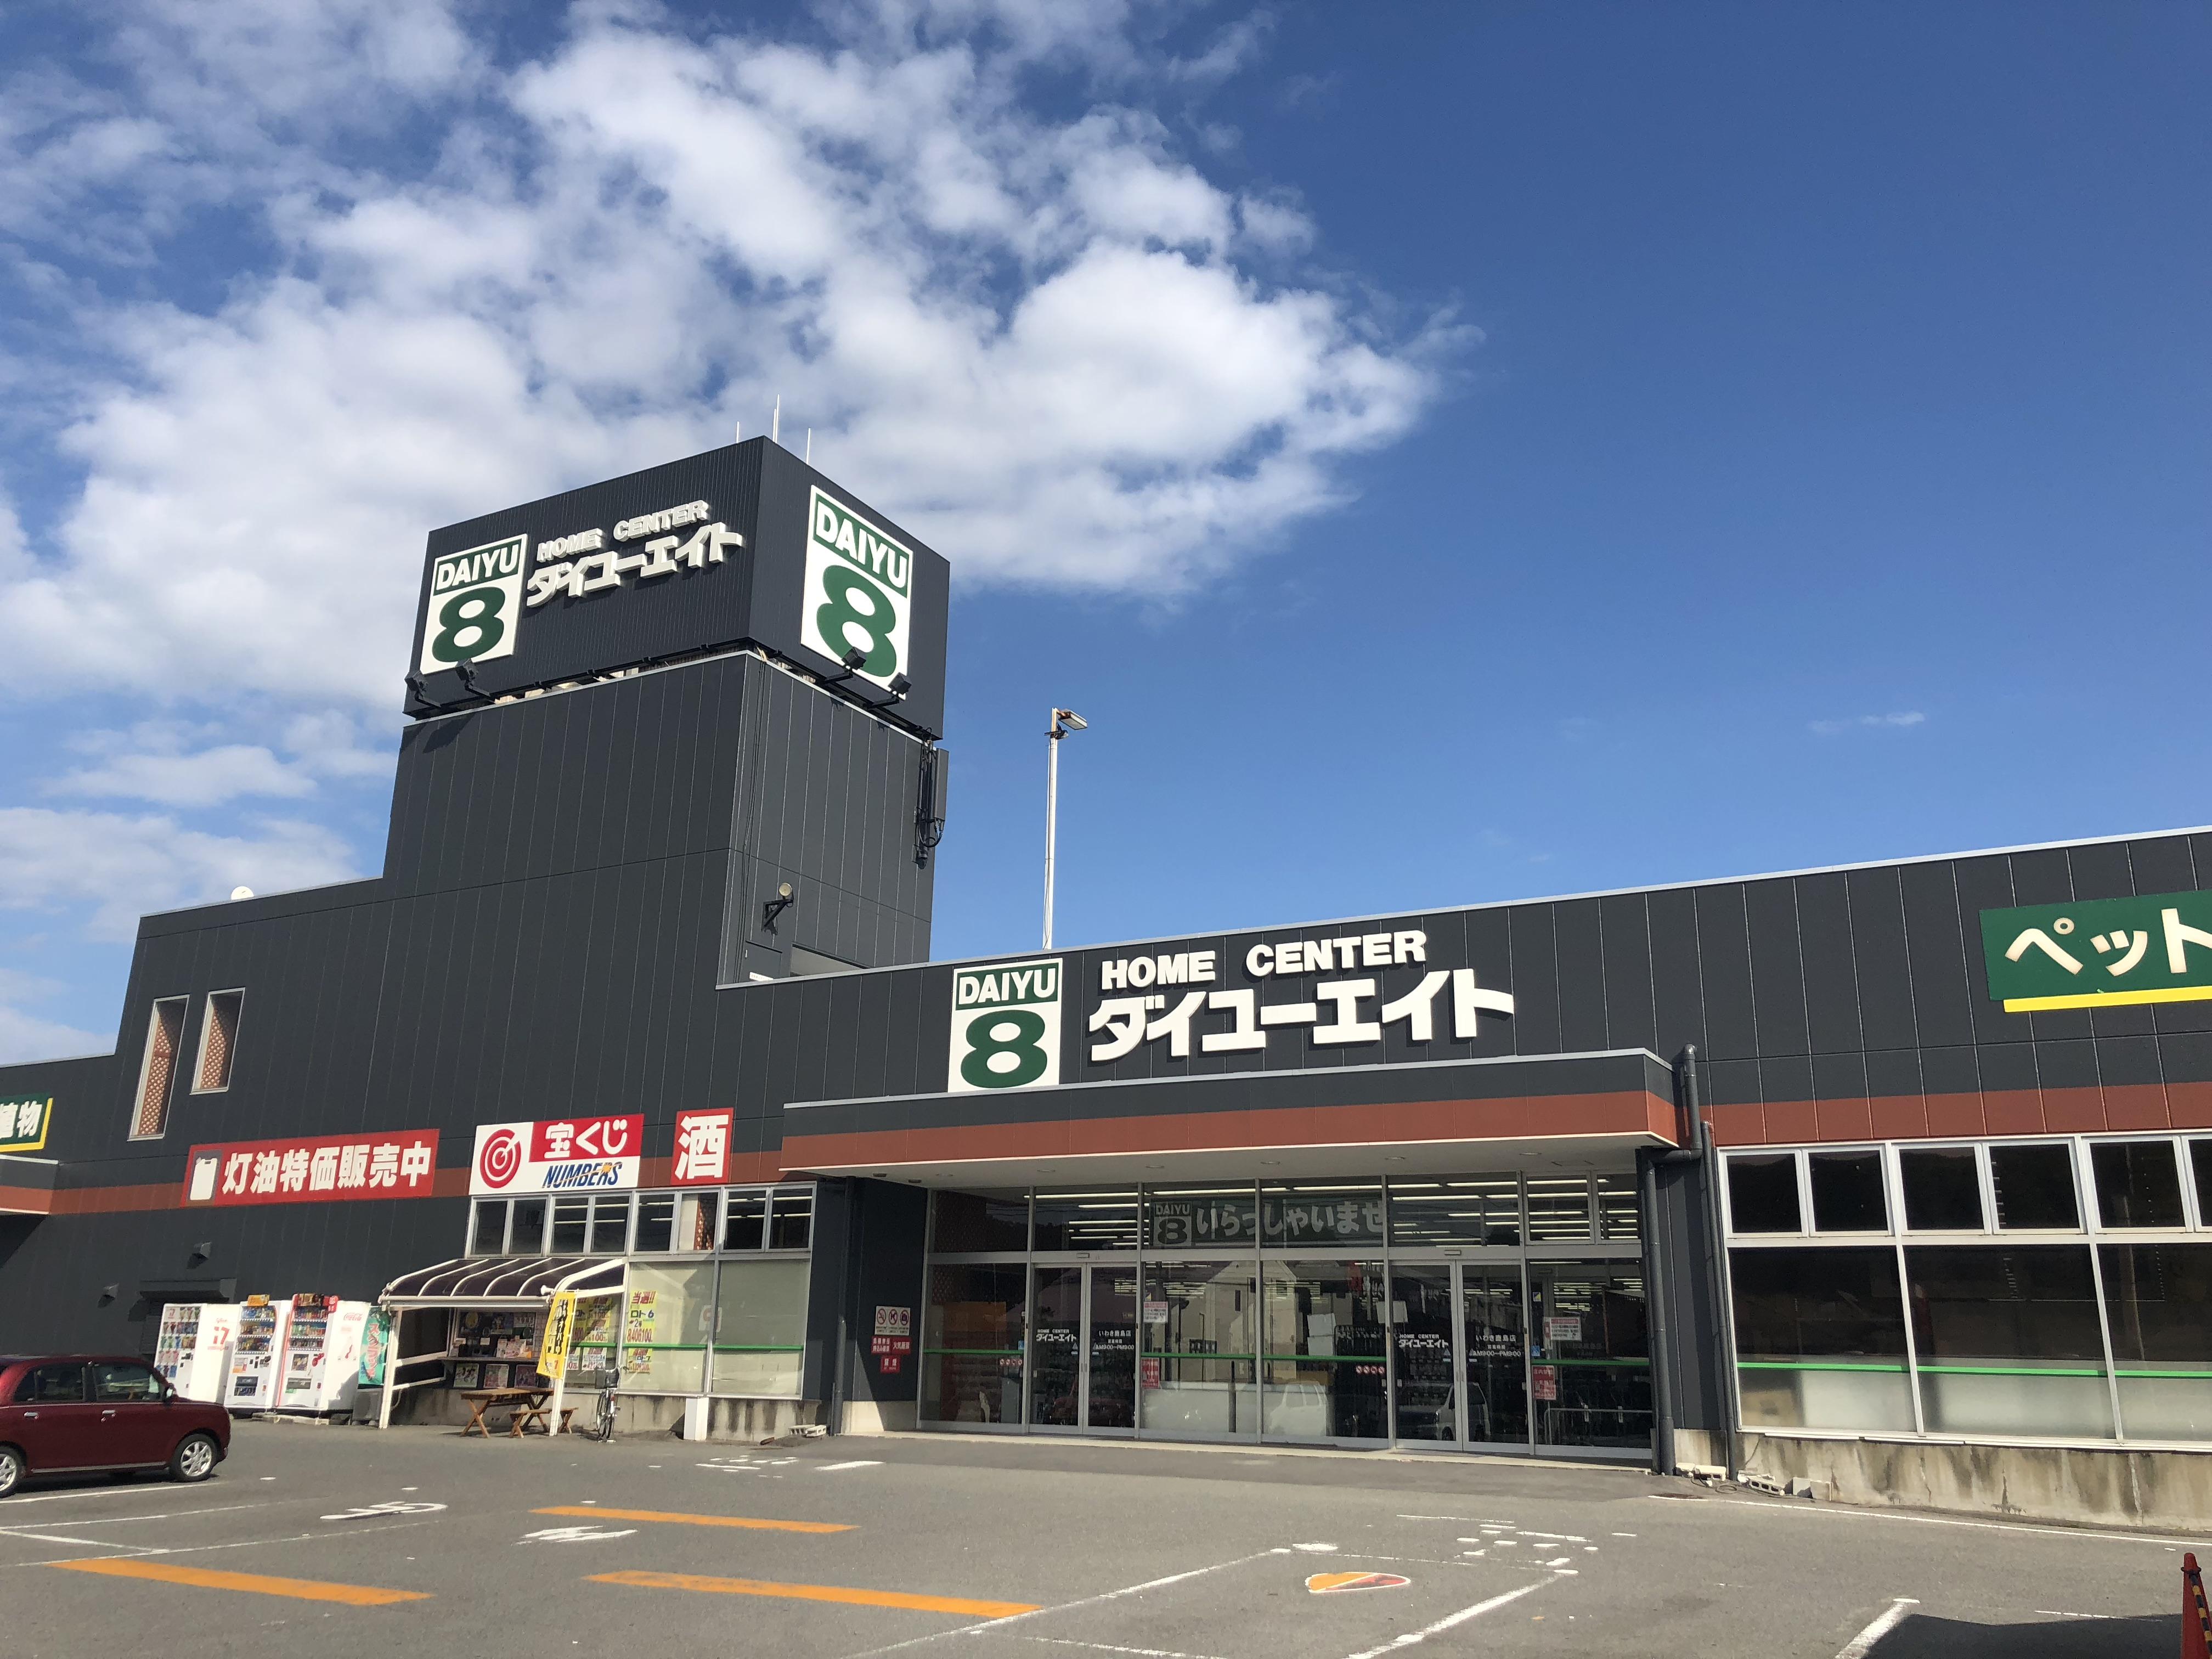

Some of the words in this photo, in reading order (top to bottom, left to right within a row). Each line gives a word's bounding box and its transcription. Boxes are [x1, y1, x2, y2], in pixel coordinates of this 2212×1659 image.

[537, 528, 605, 562] HOME
[613, 500, 709, 542] CENTER
[815, 500, 908, 589] DAIYU
[437, 543, 518, 587] DAIYU
[526, 521, 746, 607] ダイユーエイト
[432, 586, 504, 662] 8
[816, 565, 896, 678] 8
[1101, 950, 1216, 990] HOME
[1246, 930, 1427, 977] CENTER
[2005, 908, 2212, 976] ペット
[958, 969, 1056, 1006] DAIYU
[1089, 968, 1514, 1062] ダイユーエイト
[960, 1009, 1047, 1089] 8
[222, 1141, 431, 1194] 灯油特価販売中
[544, 1119, 627, 1158] 宝くじ
[674, 1114, 729, 1180] 酒
[542, 1161, 622, 1189] NUMBERS
[1155, 1203, 1190, 1216] DAIYU
[1157, 1217, 1188, 1245] 8
